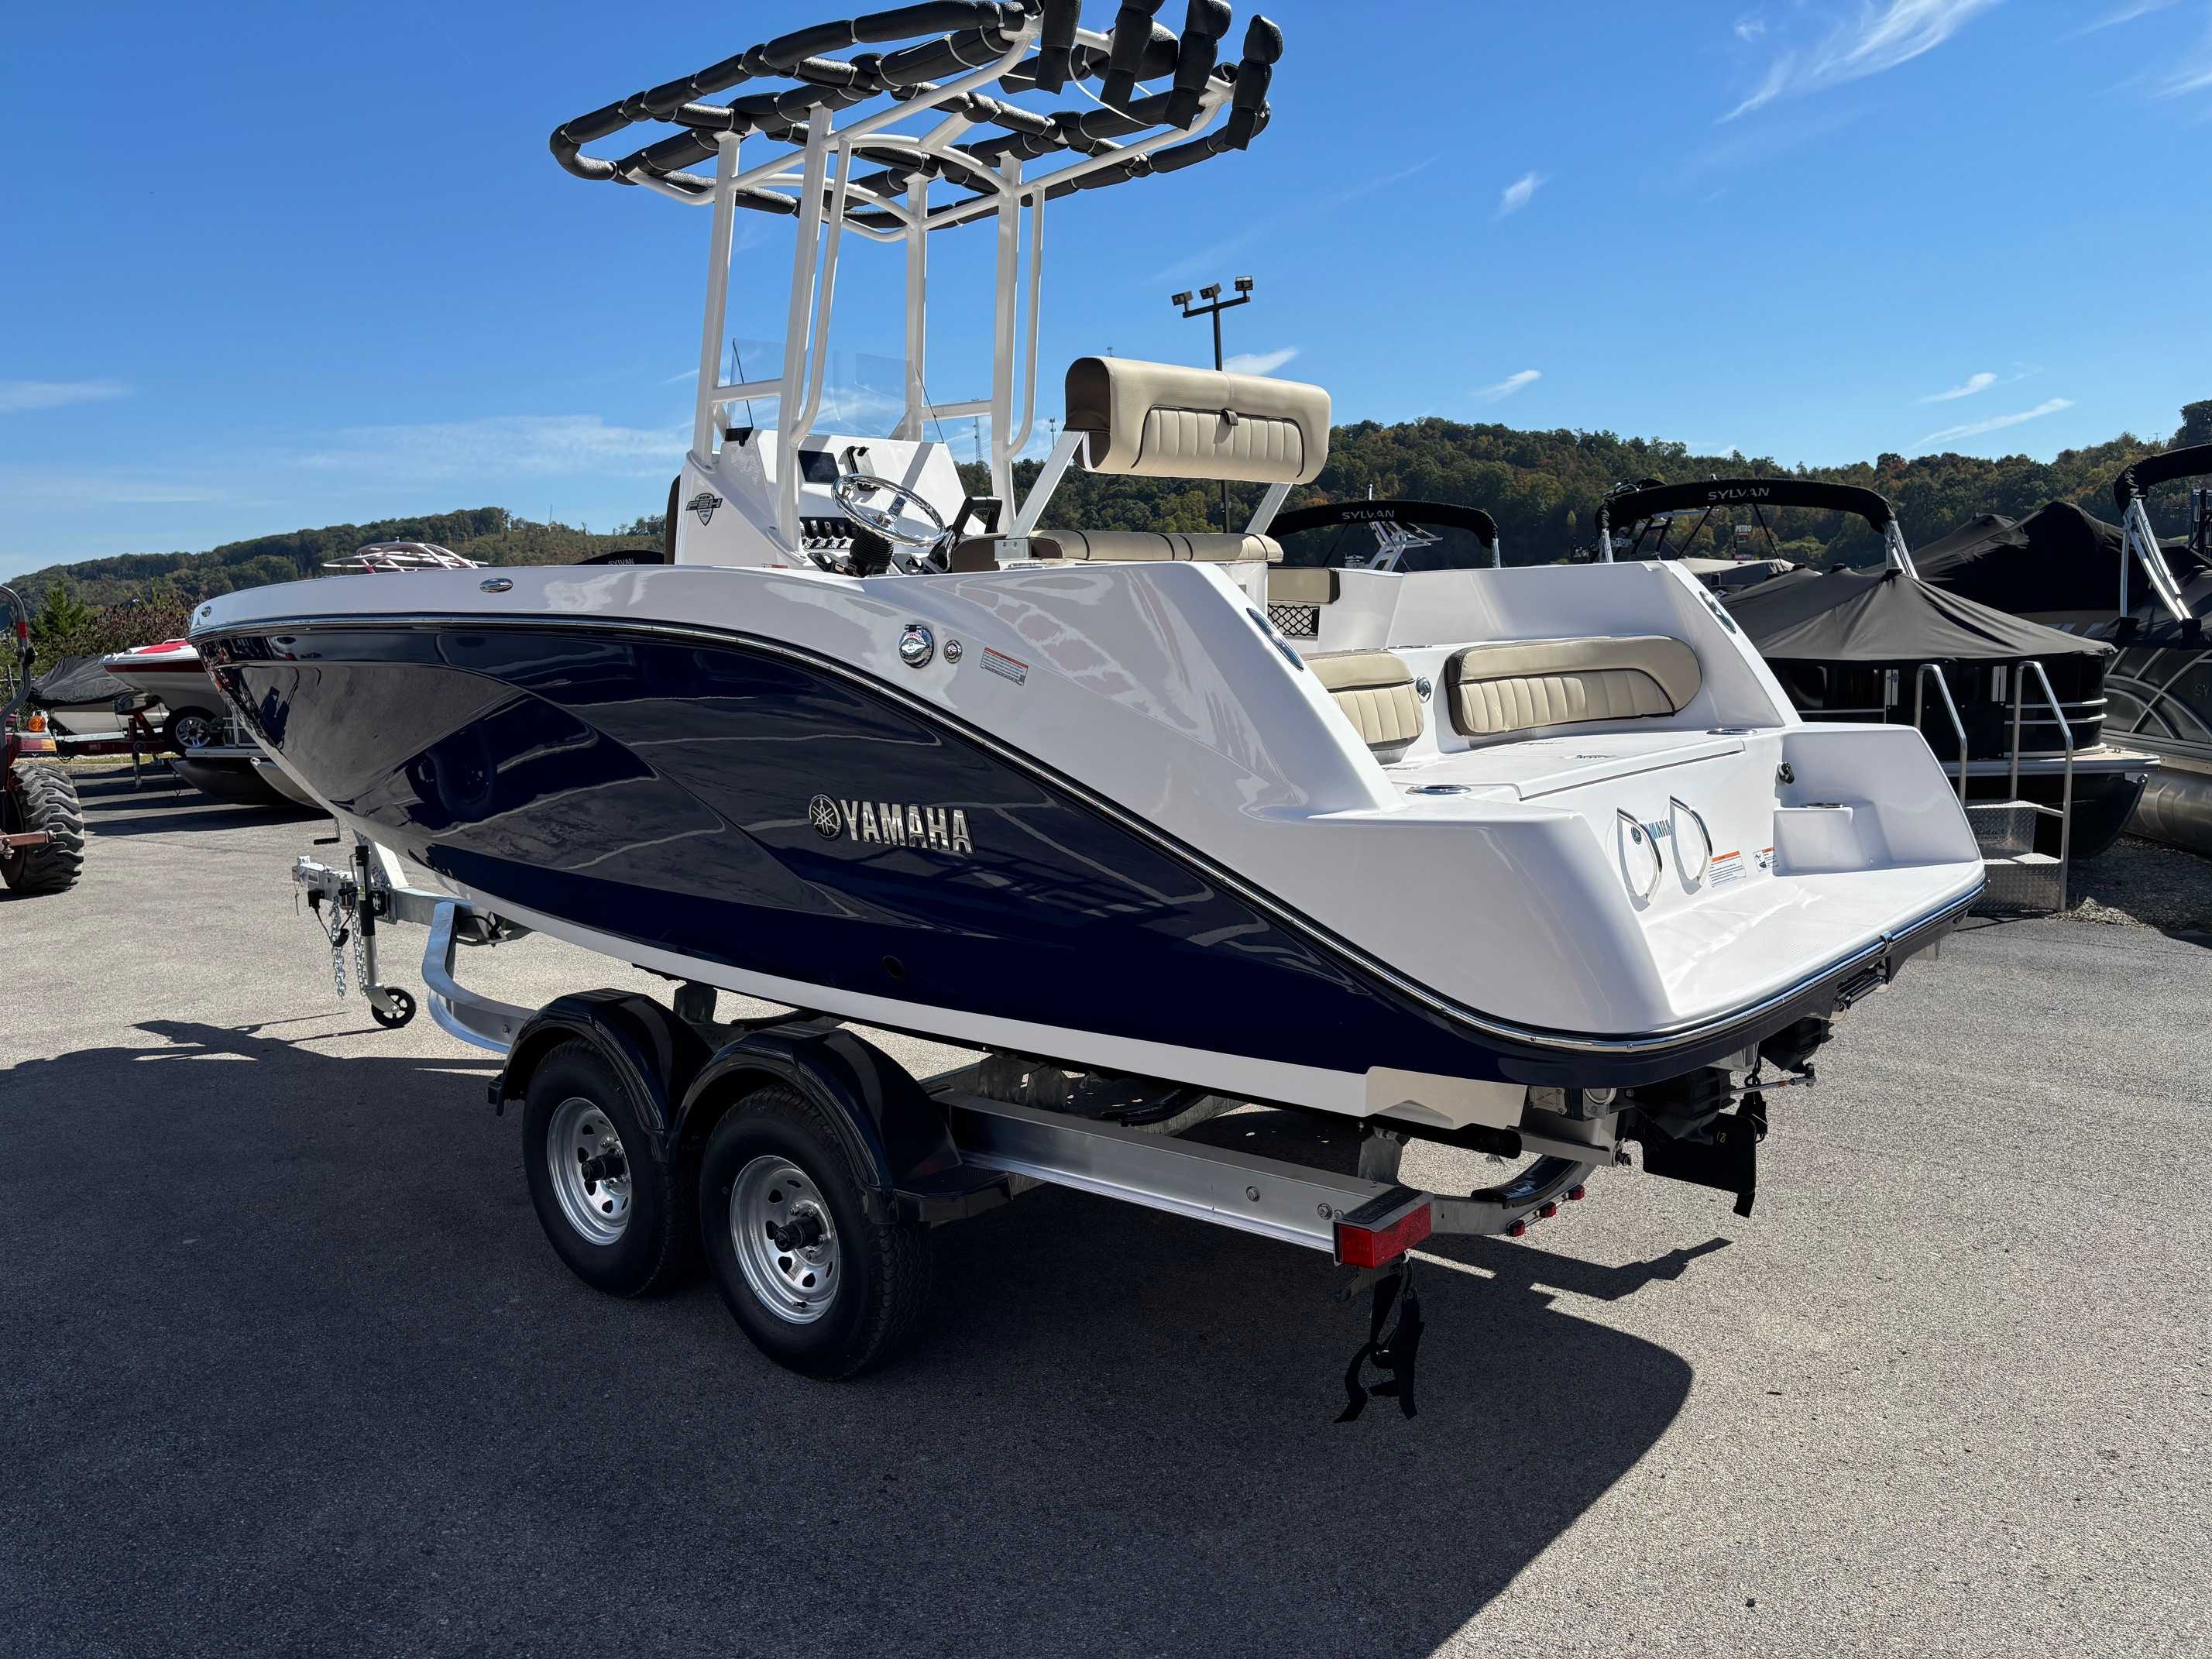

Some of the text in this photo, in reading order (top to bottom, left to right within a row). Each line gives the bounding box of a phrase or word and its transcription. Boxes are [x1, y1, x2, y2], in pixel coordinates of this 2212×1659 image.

[1708, 487, 1770, 500] SYLVAN
[1341, 510, 1395, 520] SYLVAN
[840, 799, 973, 854] YAMAHA
